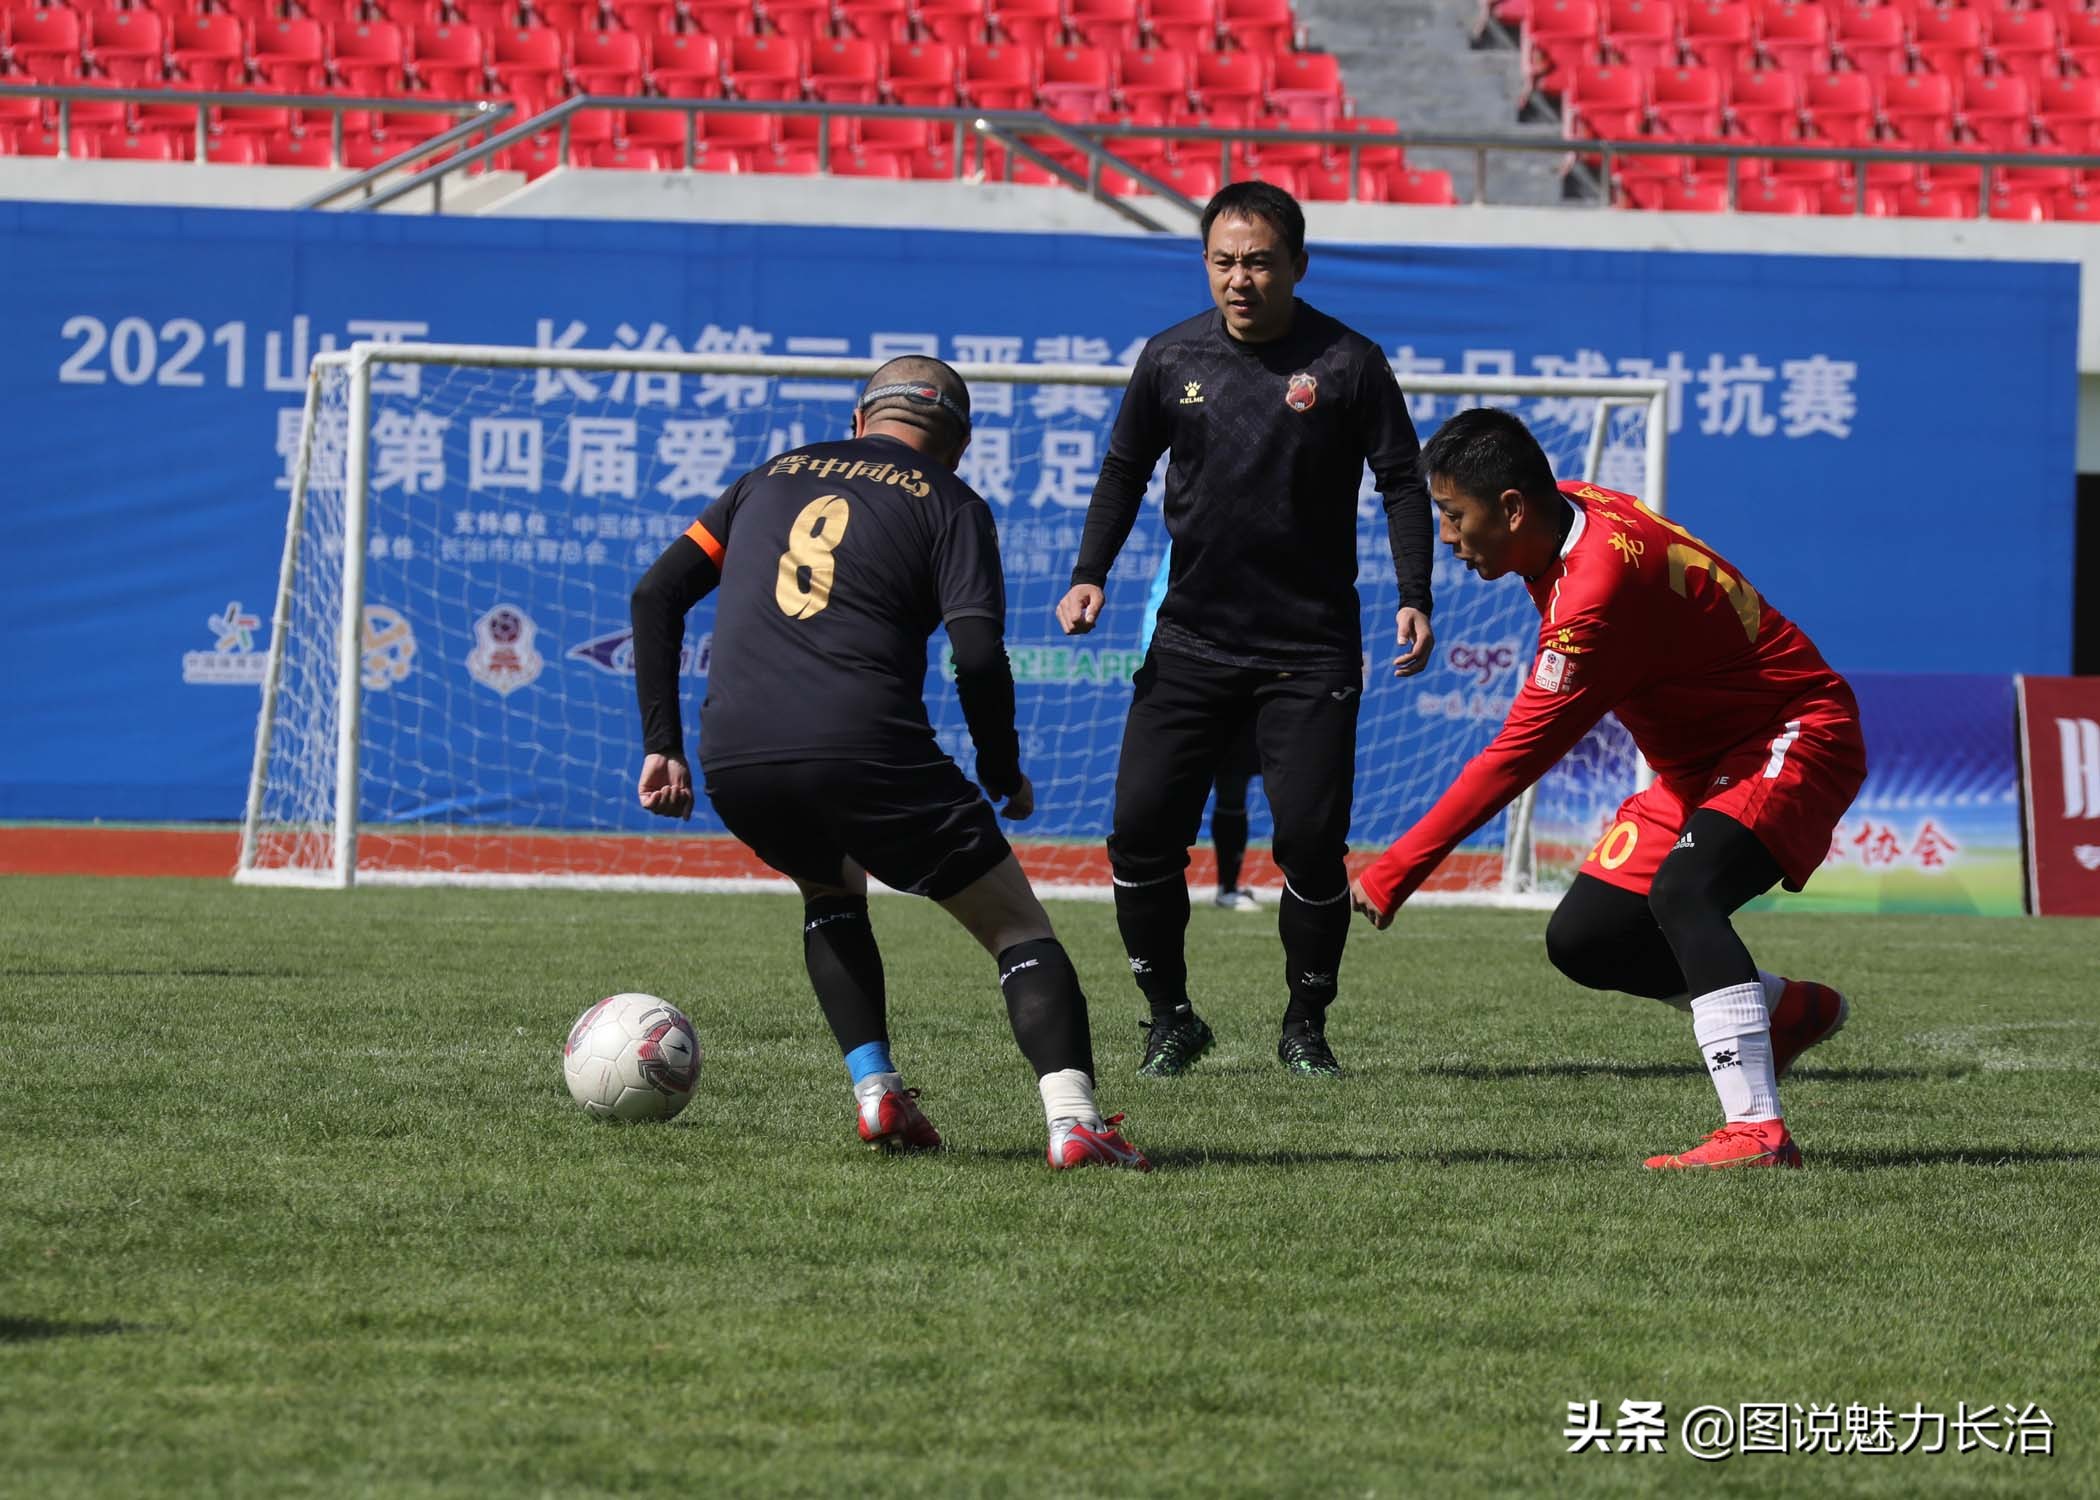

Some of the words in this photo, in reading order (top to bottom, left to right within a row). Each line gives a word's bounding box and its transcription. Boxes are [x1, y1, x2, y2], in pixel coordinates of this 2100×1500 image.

[1179, 396, 1205, 405] KELME
[767, 454, 930, 497] 晋中同心
[775, 494, 850, 620] 8
[1546, 640, 1582, 654] KELME
[1536, 675, 1558, 690] 2019
[1712, 1060, 1742, 1073] KELME
